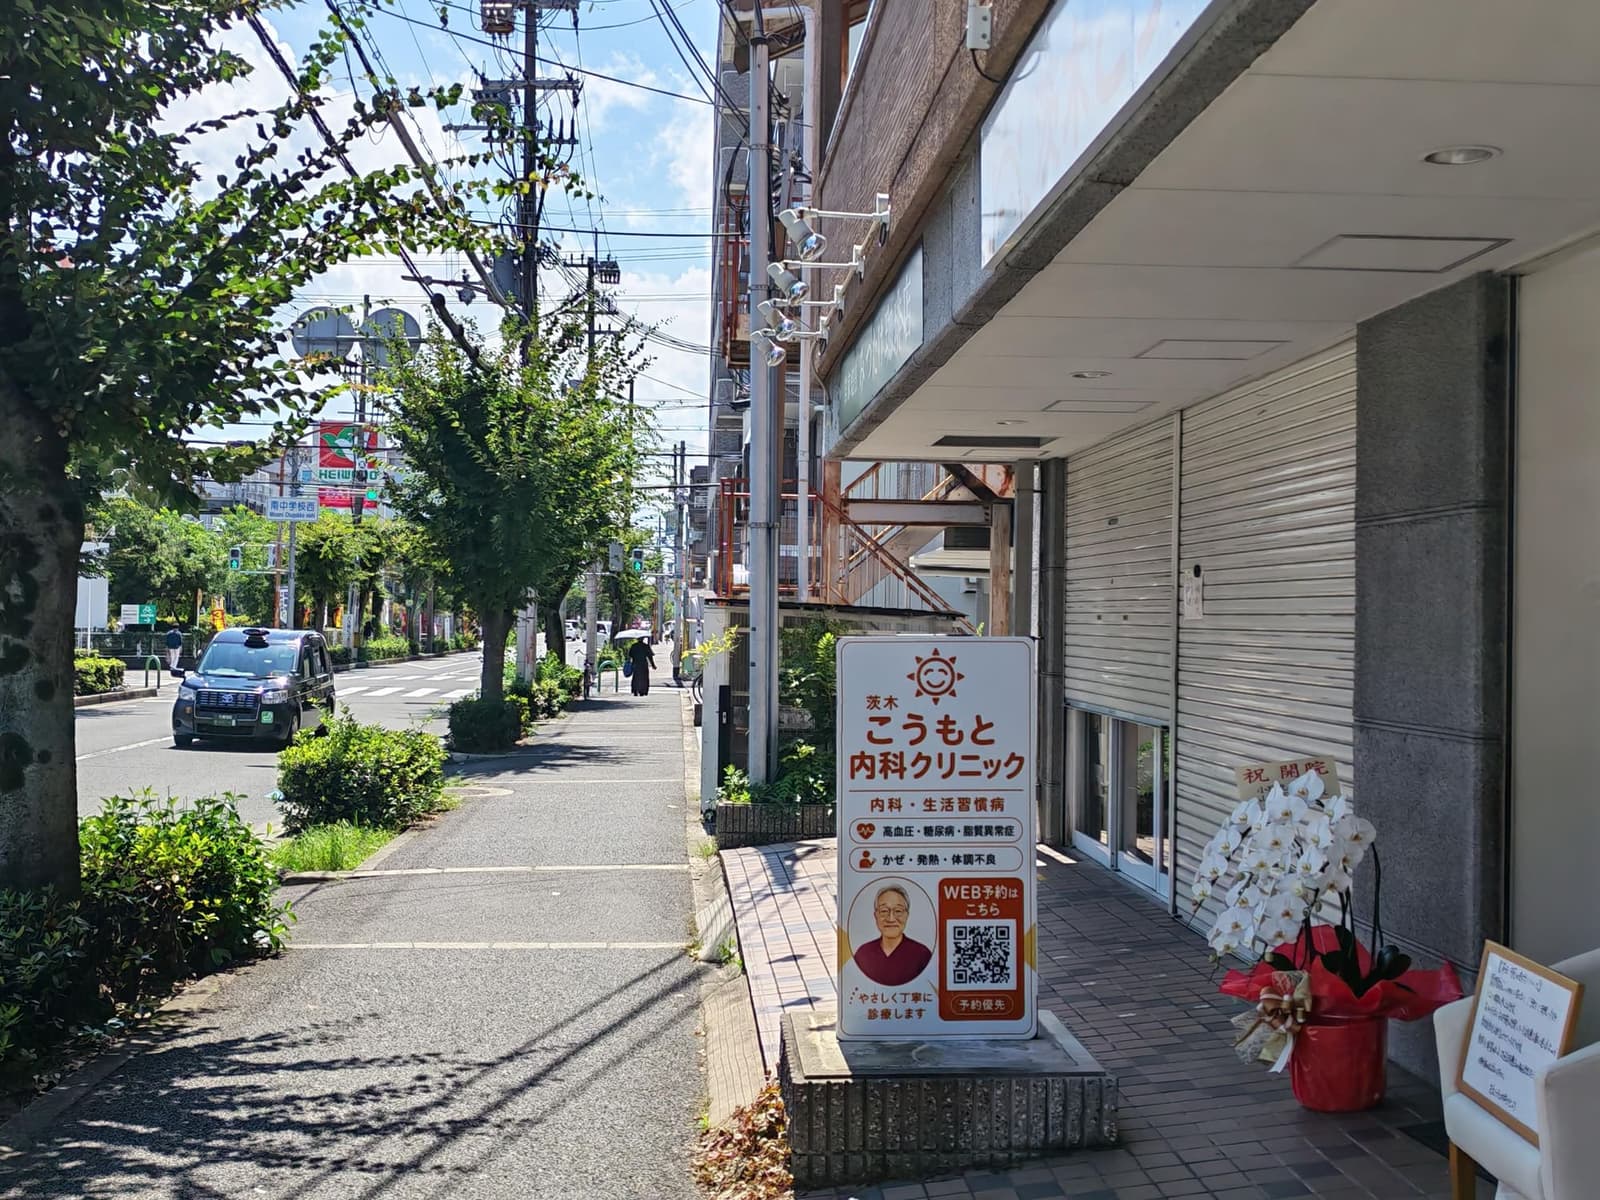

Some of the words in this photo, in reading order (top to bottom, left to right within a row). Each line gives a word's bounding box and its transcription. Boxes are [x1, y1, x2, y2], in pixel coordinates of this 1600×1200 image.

[319, 469, 377, 480] HEIWO
[271, 500, 315, 512] 南中学校西
[866, 695, 899, 710] 茨木
[866, 713, 995, 746] こうもと
[849, 750, 1025, 781] 内科クリニック
[1242, 768, 1270, 784] 祝
[870, 797, 1005, 813] 内科・生活習慣病
[882, 825, 1015, 838] 高血圧・糖尿病・脂質異常症
[882, 853, 997, 867] かぜ・発熱・体調不良
[943, 884, 1019, 900] WEB予約は
[965, 903, 1001, 917] こちら
[858, 991, 933, 1004] やさしく丁寧に
[958, 998, 1006, 1012] 予約優先
[867, 1007, 927, 1020] 診療します
